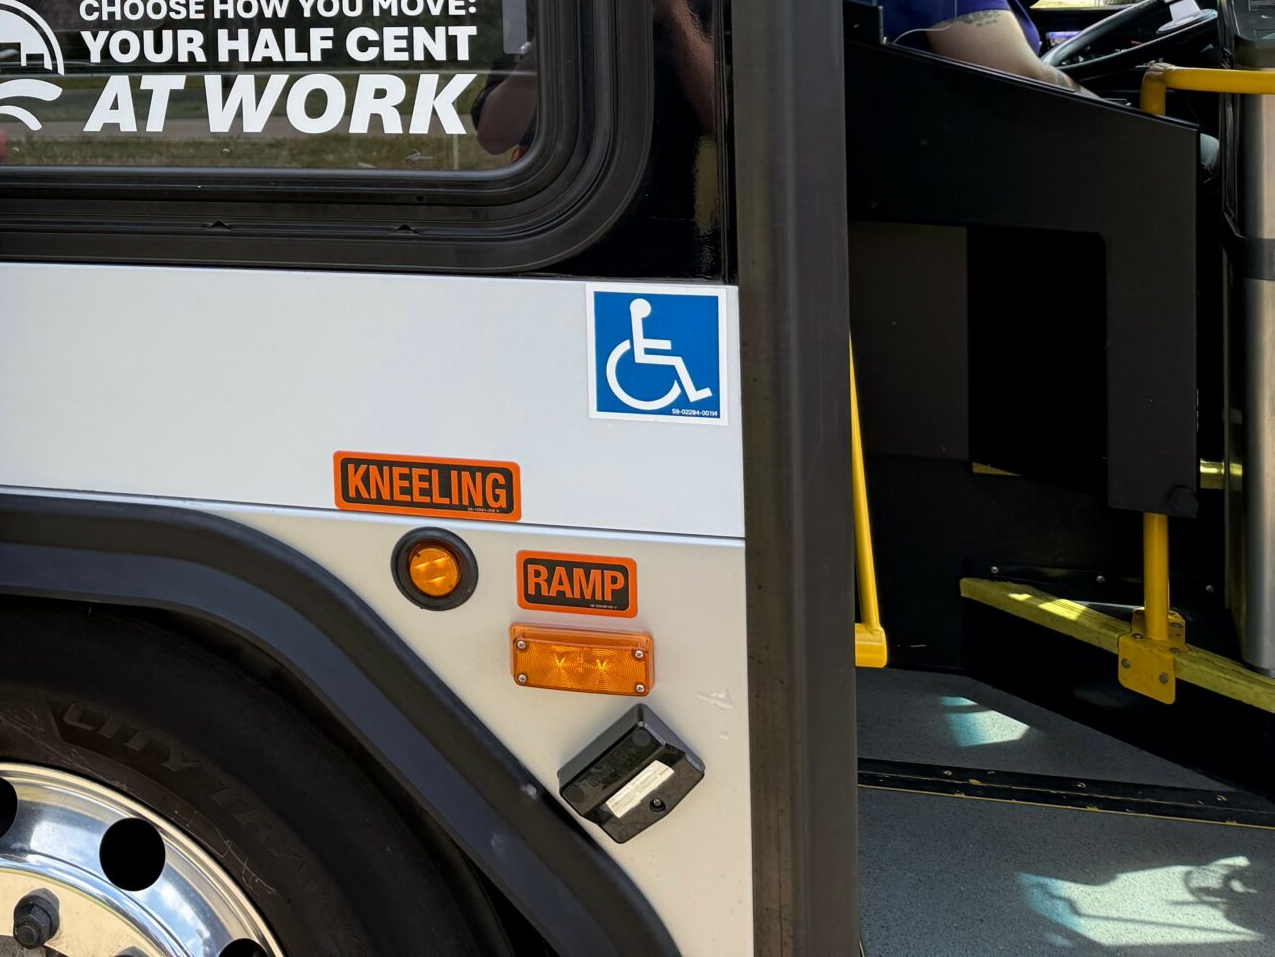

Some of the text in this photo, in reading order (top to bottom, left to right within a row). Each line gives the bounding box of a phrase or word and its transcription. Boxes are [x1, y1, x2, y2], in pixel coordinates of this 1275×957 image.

[81, 26, 476, 62] YOUR HALF CENT
[84, 74, 477, 134] AT WORK
[347, 463, 508, 509] KNEELING
[527, 564, 625, 602] RAMP
